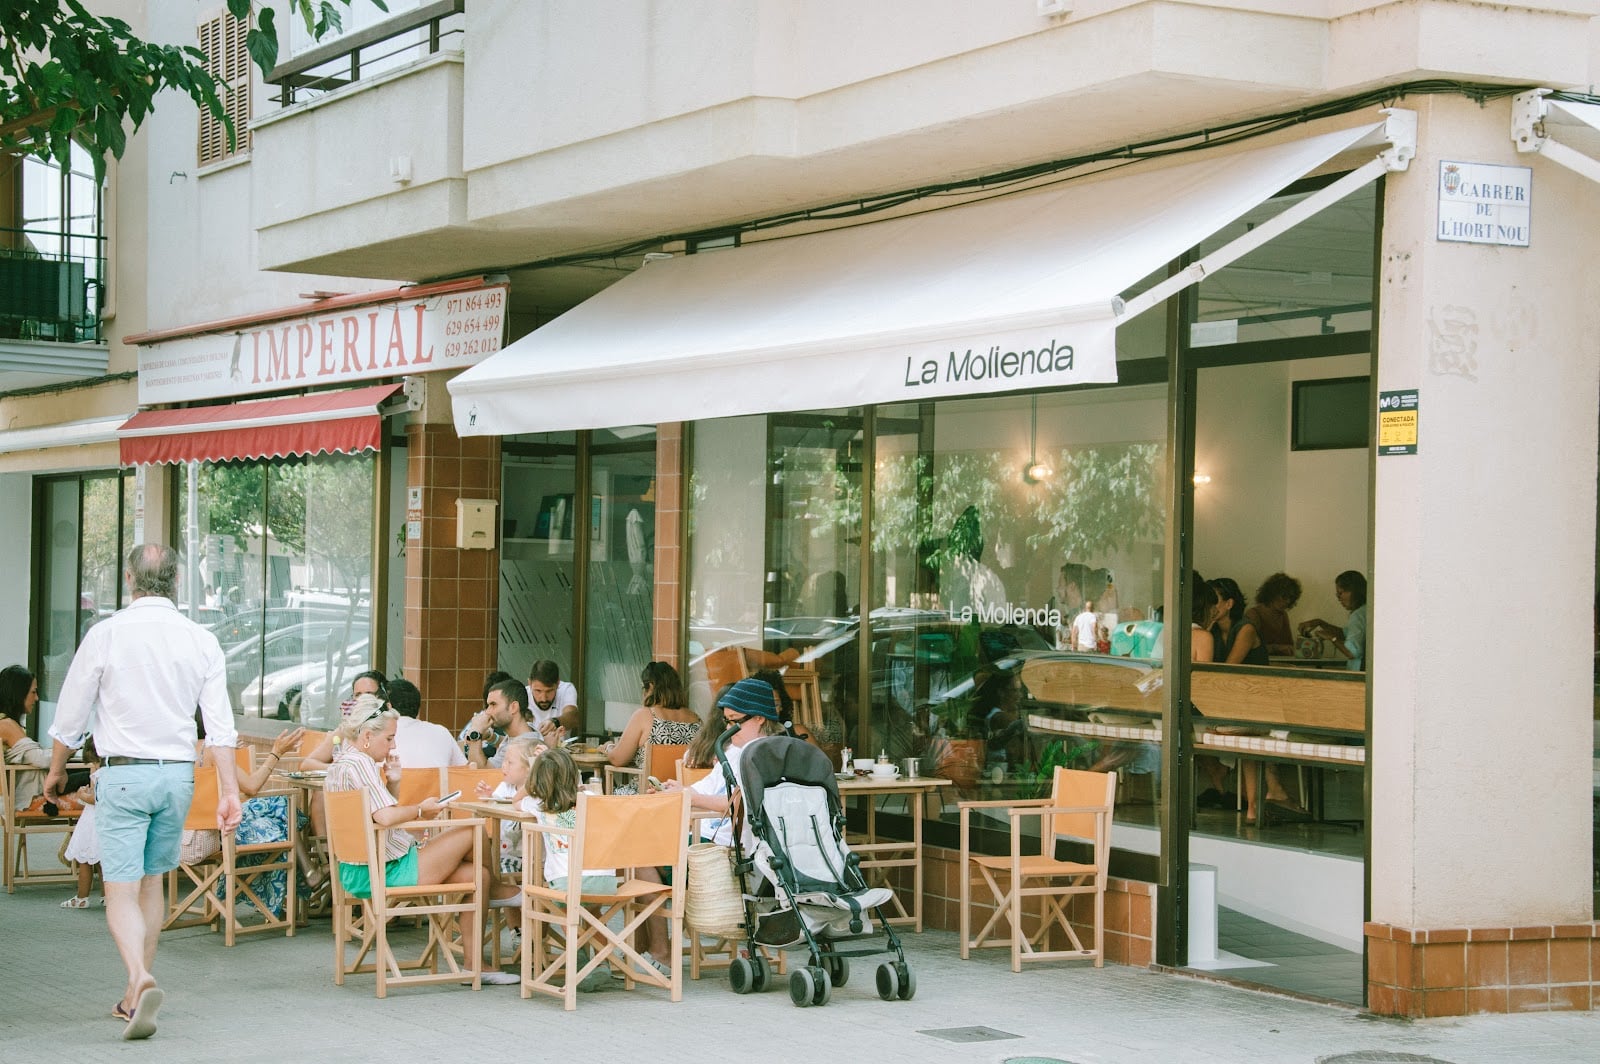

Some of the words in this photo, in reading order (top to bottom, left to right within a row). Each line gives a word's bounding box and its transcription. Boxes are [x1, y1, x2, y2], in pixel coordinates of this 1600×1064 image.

[1460, 182, 1525, 201] CARRER
[1476, 203, 1493, 216] DE
[1496, 224, 1527, 241] NOU
[447, 298, 462, 315] 971
[465, 294, 482, 311] 864
[484, 292, 501, 309] 493
[446, 320, 462, 336] 629
[464, 316, 481, 333] 654
[483, 314, 500, 331] 499
[251, 303, 434, 384] IMPERIAL
[445, 342, 461, 358] 629
[463, 339, 479, 355] 262
[481, 337, 497, 353] 012
[904, 356, 938, 387] La
[946, 339, 1074, 382] Molienda
[1382, 415, 1415, 423] CONECTADA
[949, 600, 973, 625] La
[978, 602, 1061, 627] Molienda
